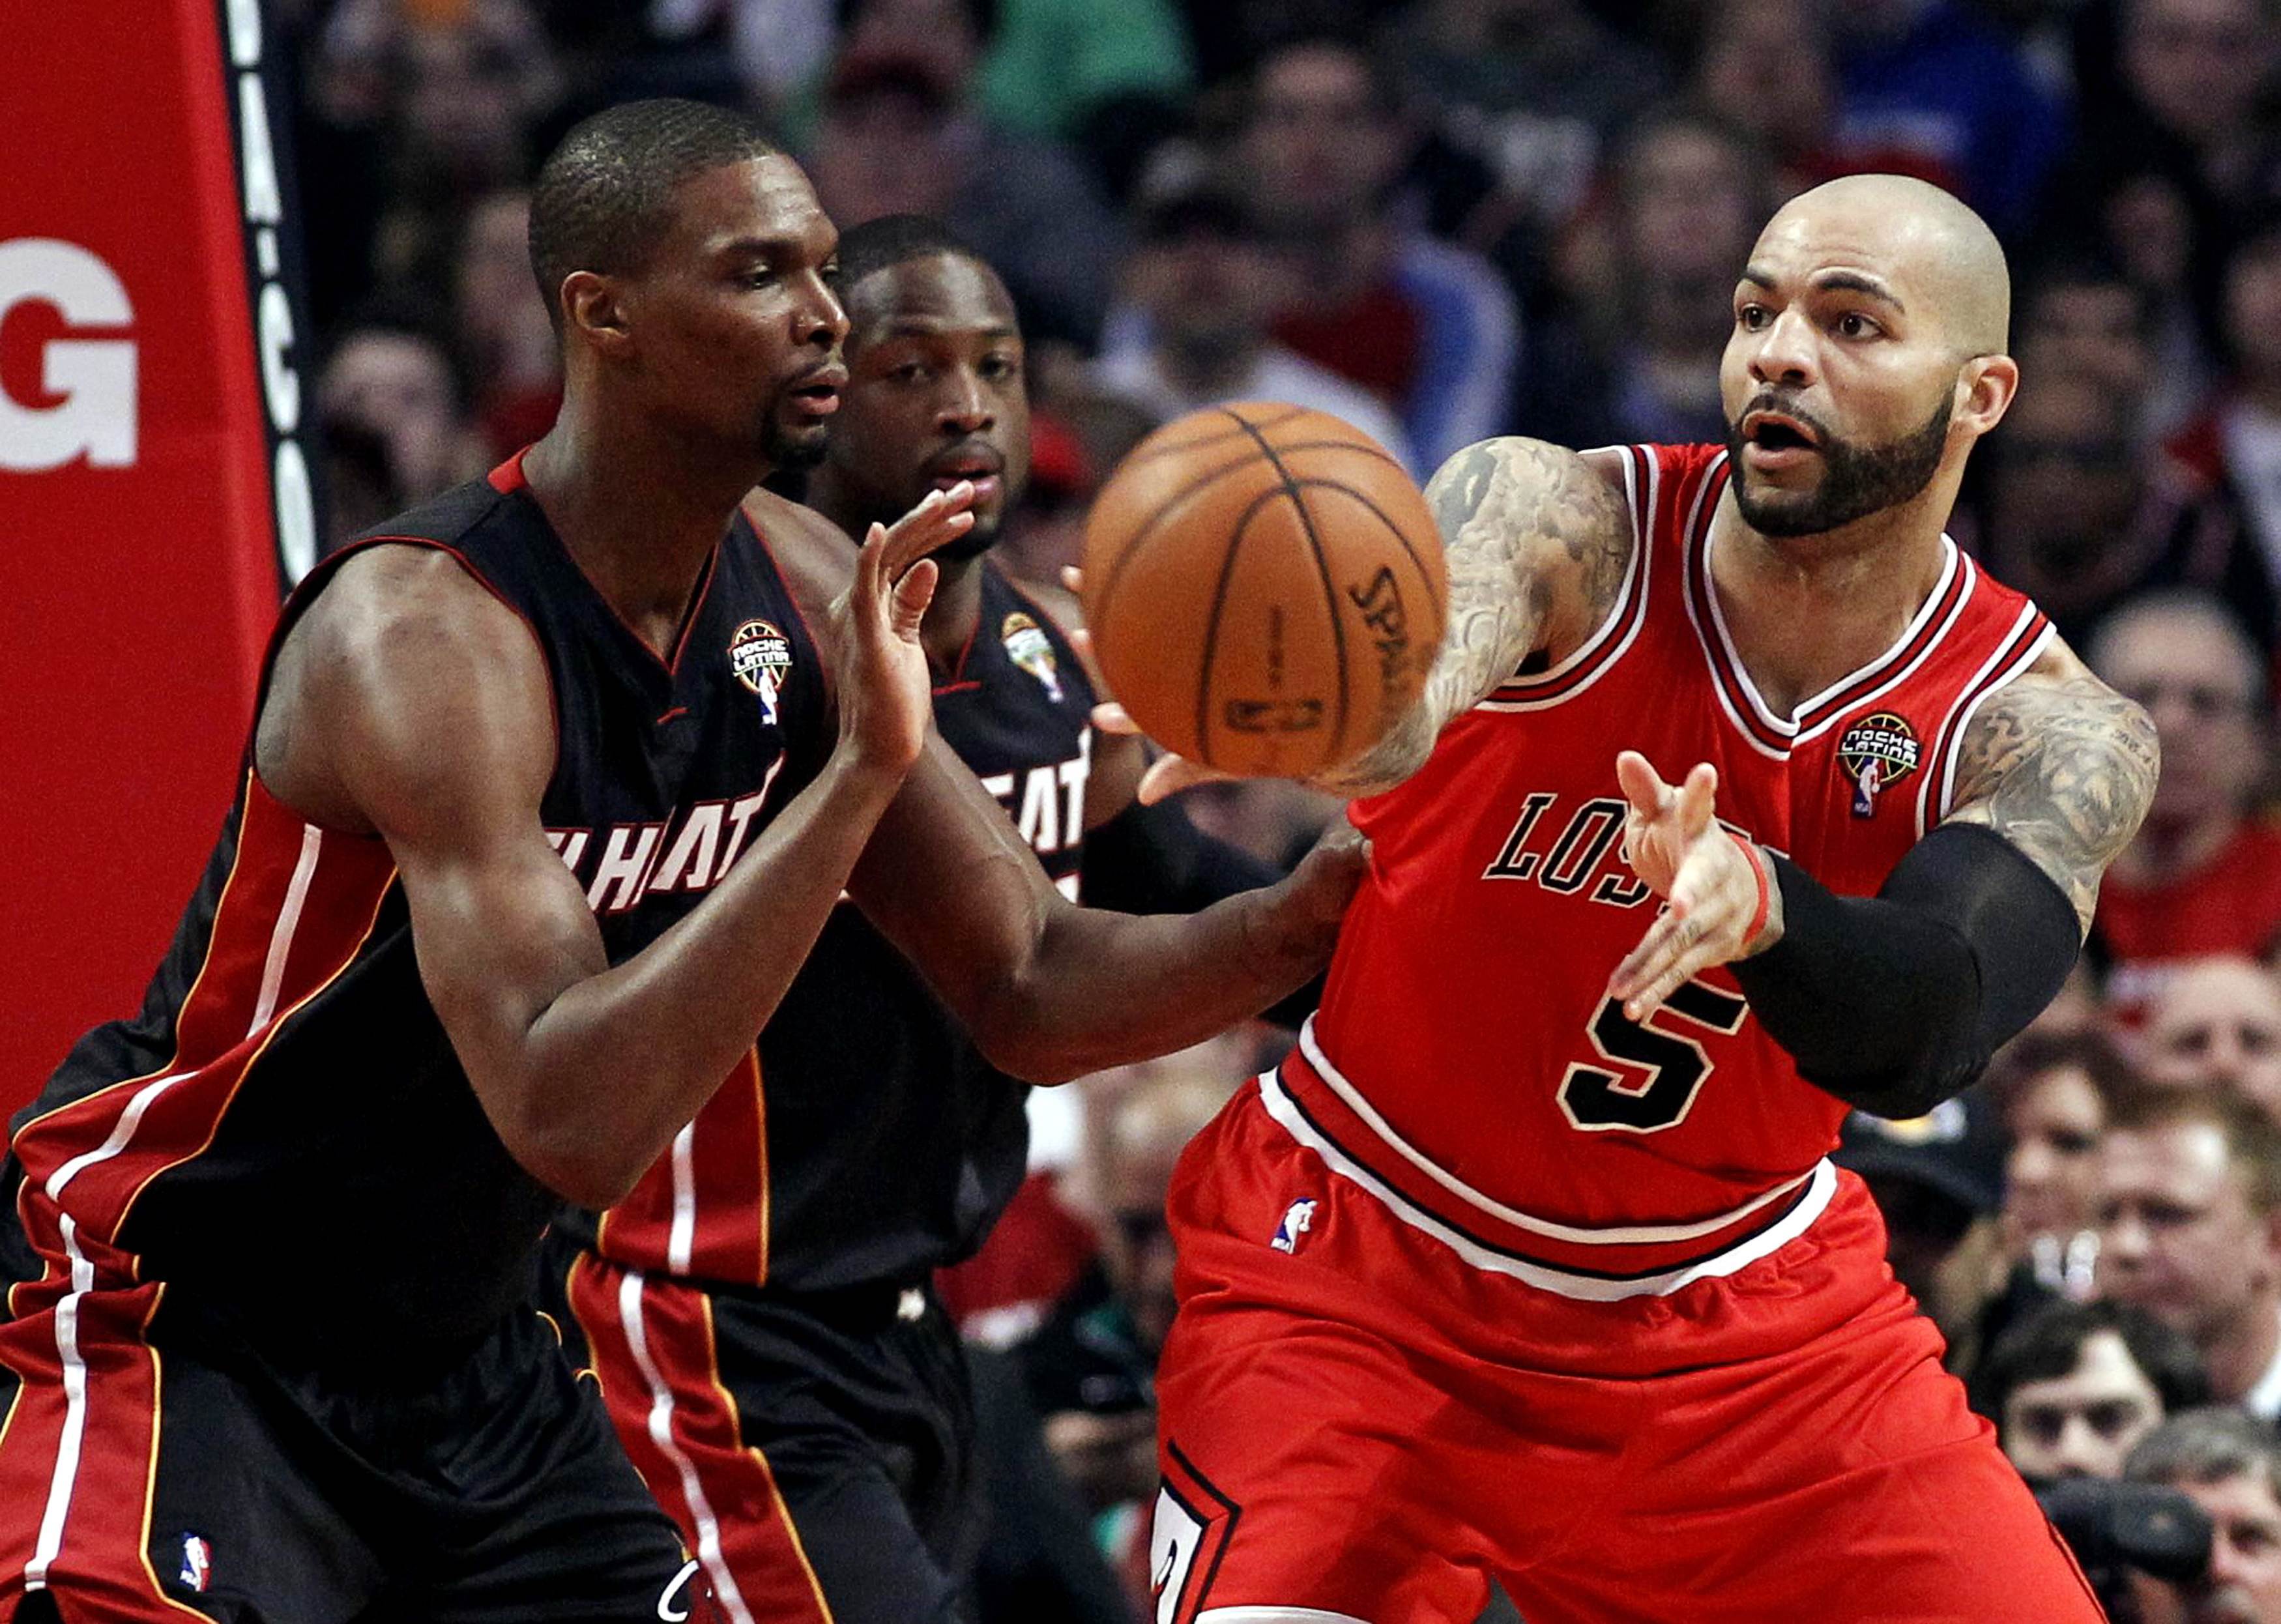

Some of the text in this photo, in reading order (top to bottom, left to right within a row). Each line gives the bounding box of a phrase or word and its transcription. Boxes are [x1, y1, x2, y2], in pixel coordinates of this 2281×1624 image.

[0, 236, 138, 473] G
[733, 639, 787, 661] NOCHE
[733, 652, 789, 673] LATINA
[1841, 740, 1917, 764] LATINA
[1847, 730, 1919, 752] NOCHE
[1555, 977, 1751, 1134] 5
